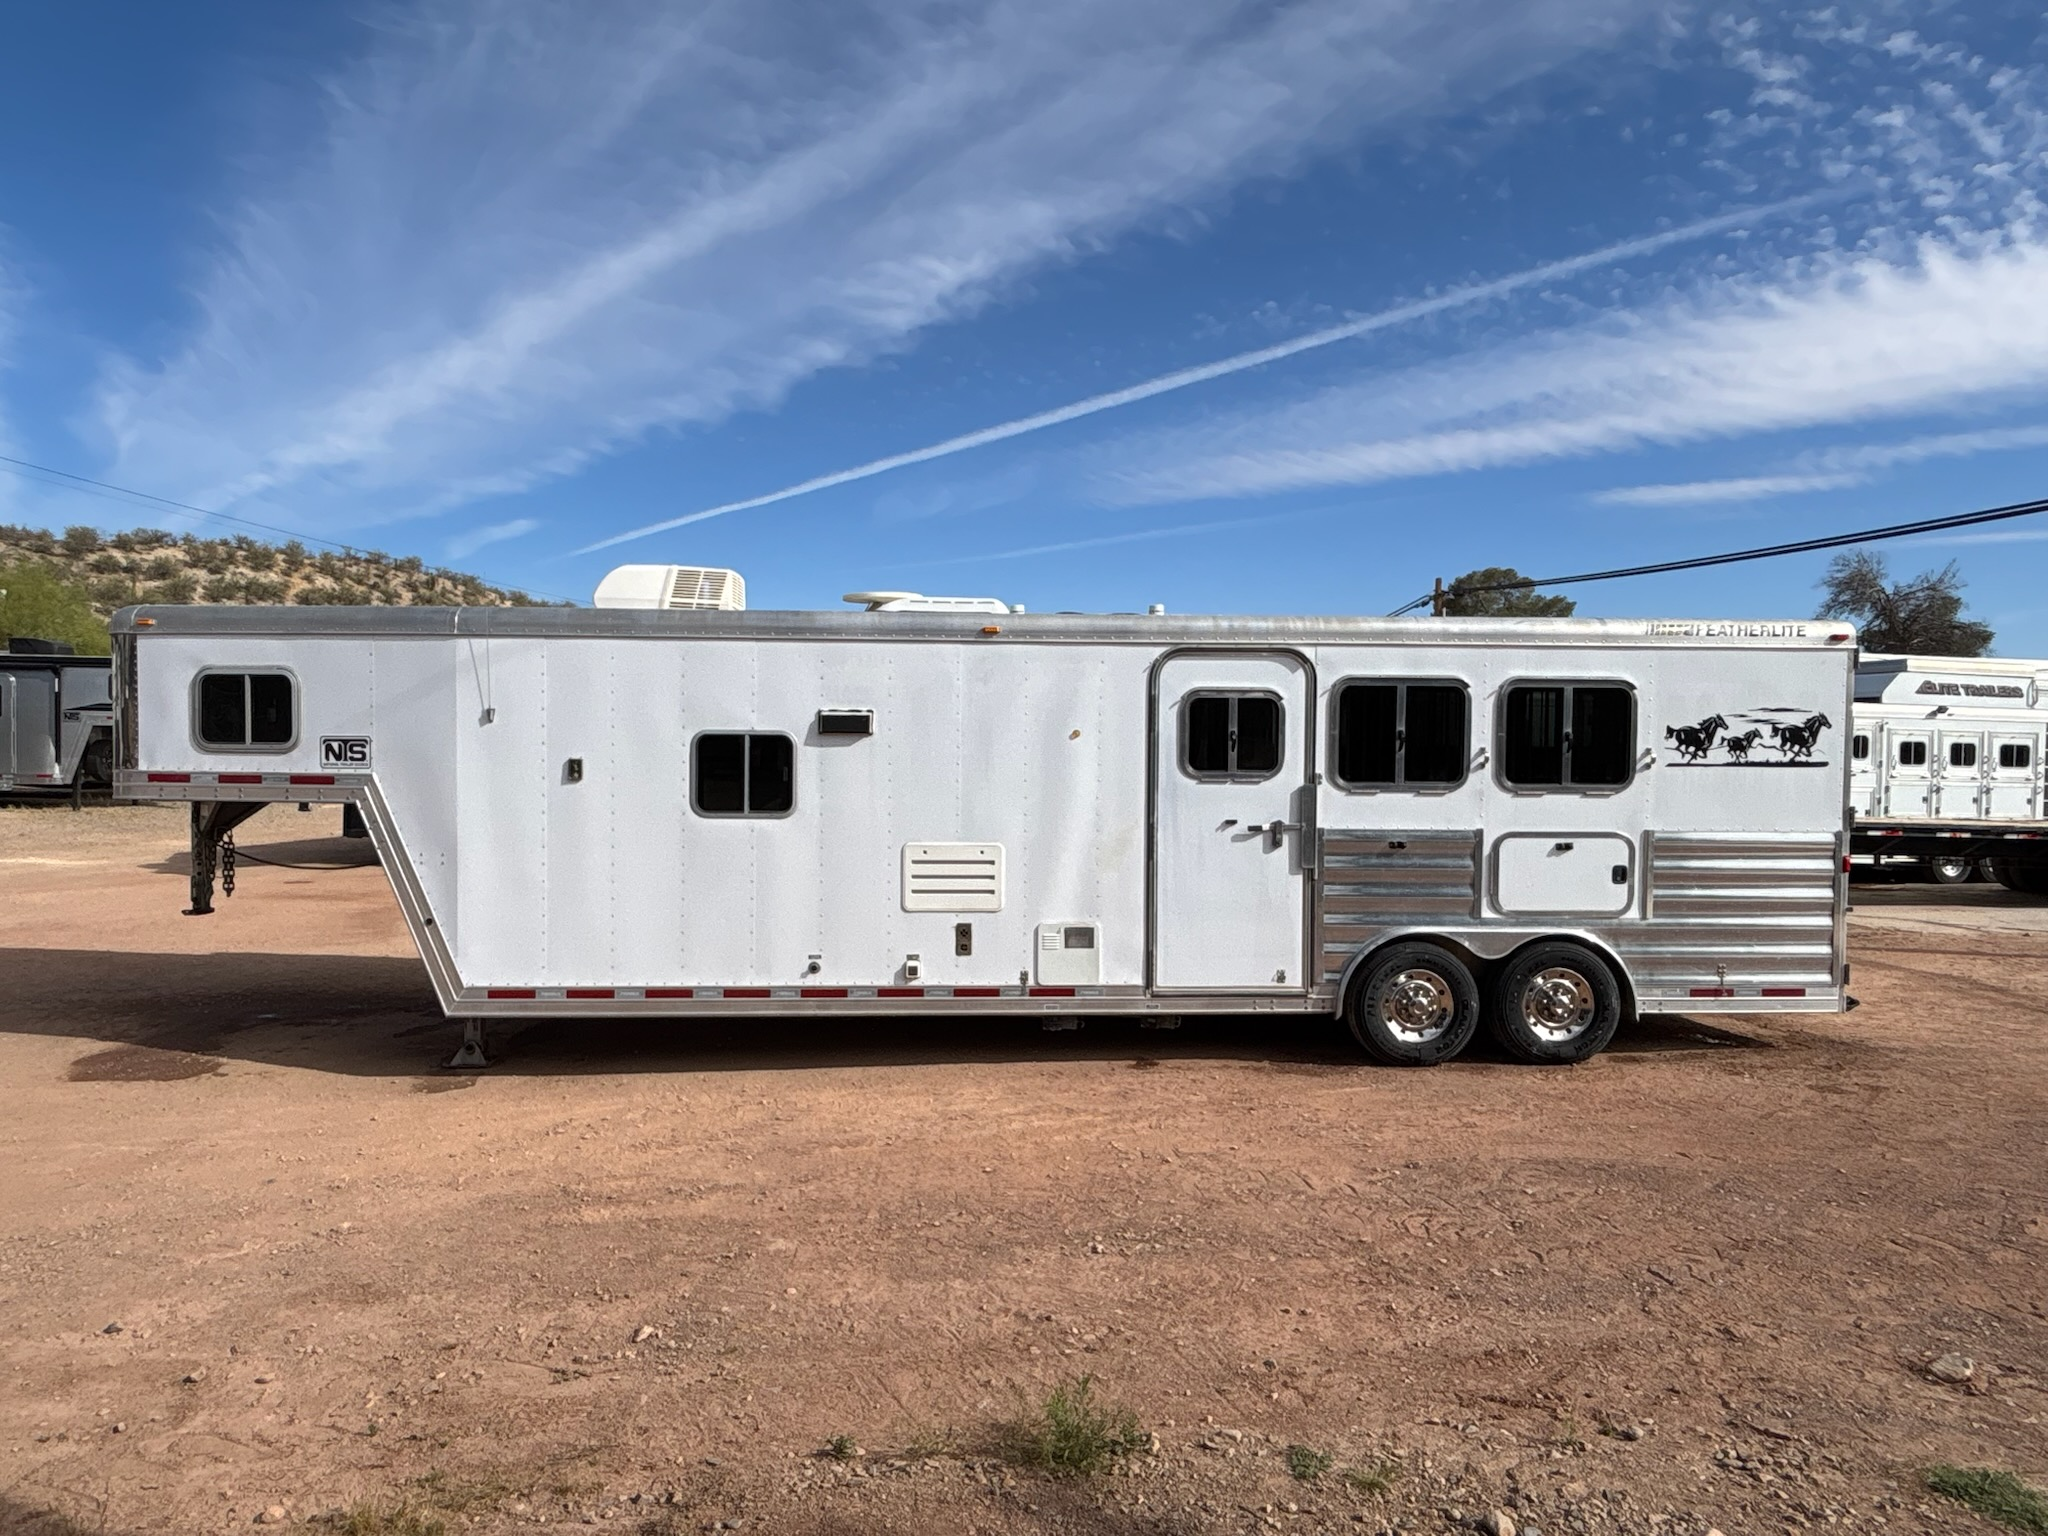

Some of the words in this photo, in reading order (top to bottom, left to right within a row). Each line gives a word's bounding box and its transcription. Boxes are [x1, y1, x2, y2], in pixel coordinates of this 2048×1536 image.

[1695, 624, 1807, 638] FEATHERLITE
[1914, 679, 1962, 697] ELITE
[1960, 683, 2025, 699] TRAILERS
